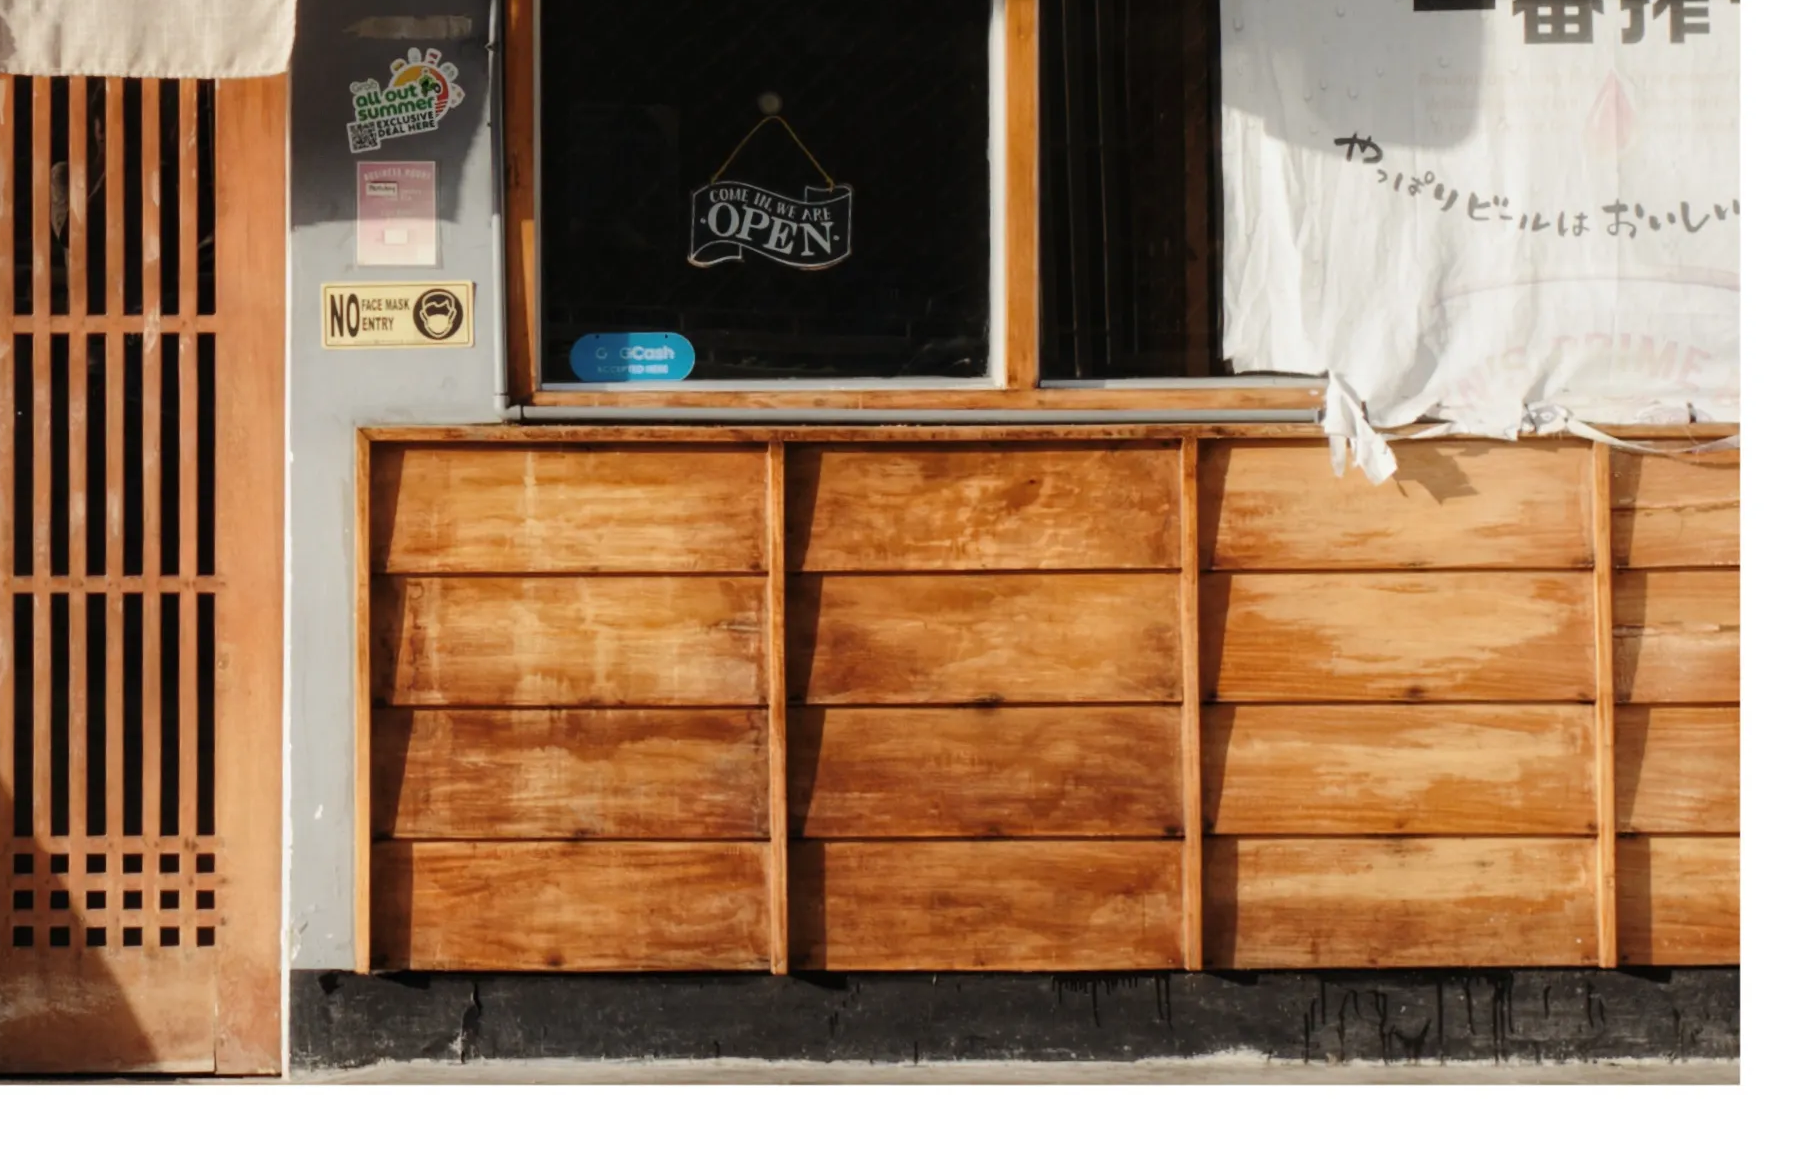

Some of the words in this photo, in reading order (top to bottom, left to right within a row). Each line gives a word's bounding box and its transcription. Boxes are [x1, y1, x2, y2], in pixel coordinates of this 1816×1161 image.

[356, 91, 382, 107] all
[385, 84, 419, 101] out
[358, 97, 435, 121] summer
[377, 111, 434, 129] EXCLUSIVE
[378, 125, 406, 138] DEAL
[408, 119, 436, 132] HERE
[709, 188, 749, 203] COME
[776, 201, 797, 219] WE
[801, 207, 831, 221] ARE
[707, 202, 834, 257] OPEN
[330, 293, 360, 337] NO
[361, 298, 383, 311] FACE
[385, 298, 410, 310] MASK
[362, 317, 394, 331] ENTRY
[619, 346, 676, 360] GCash
